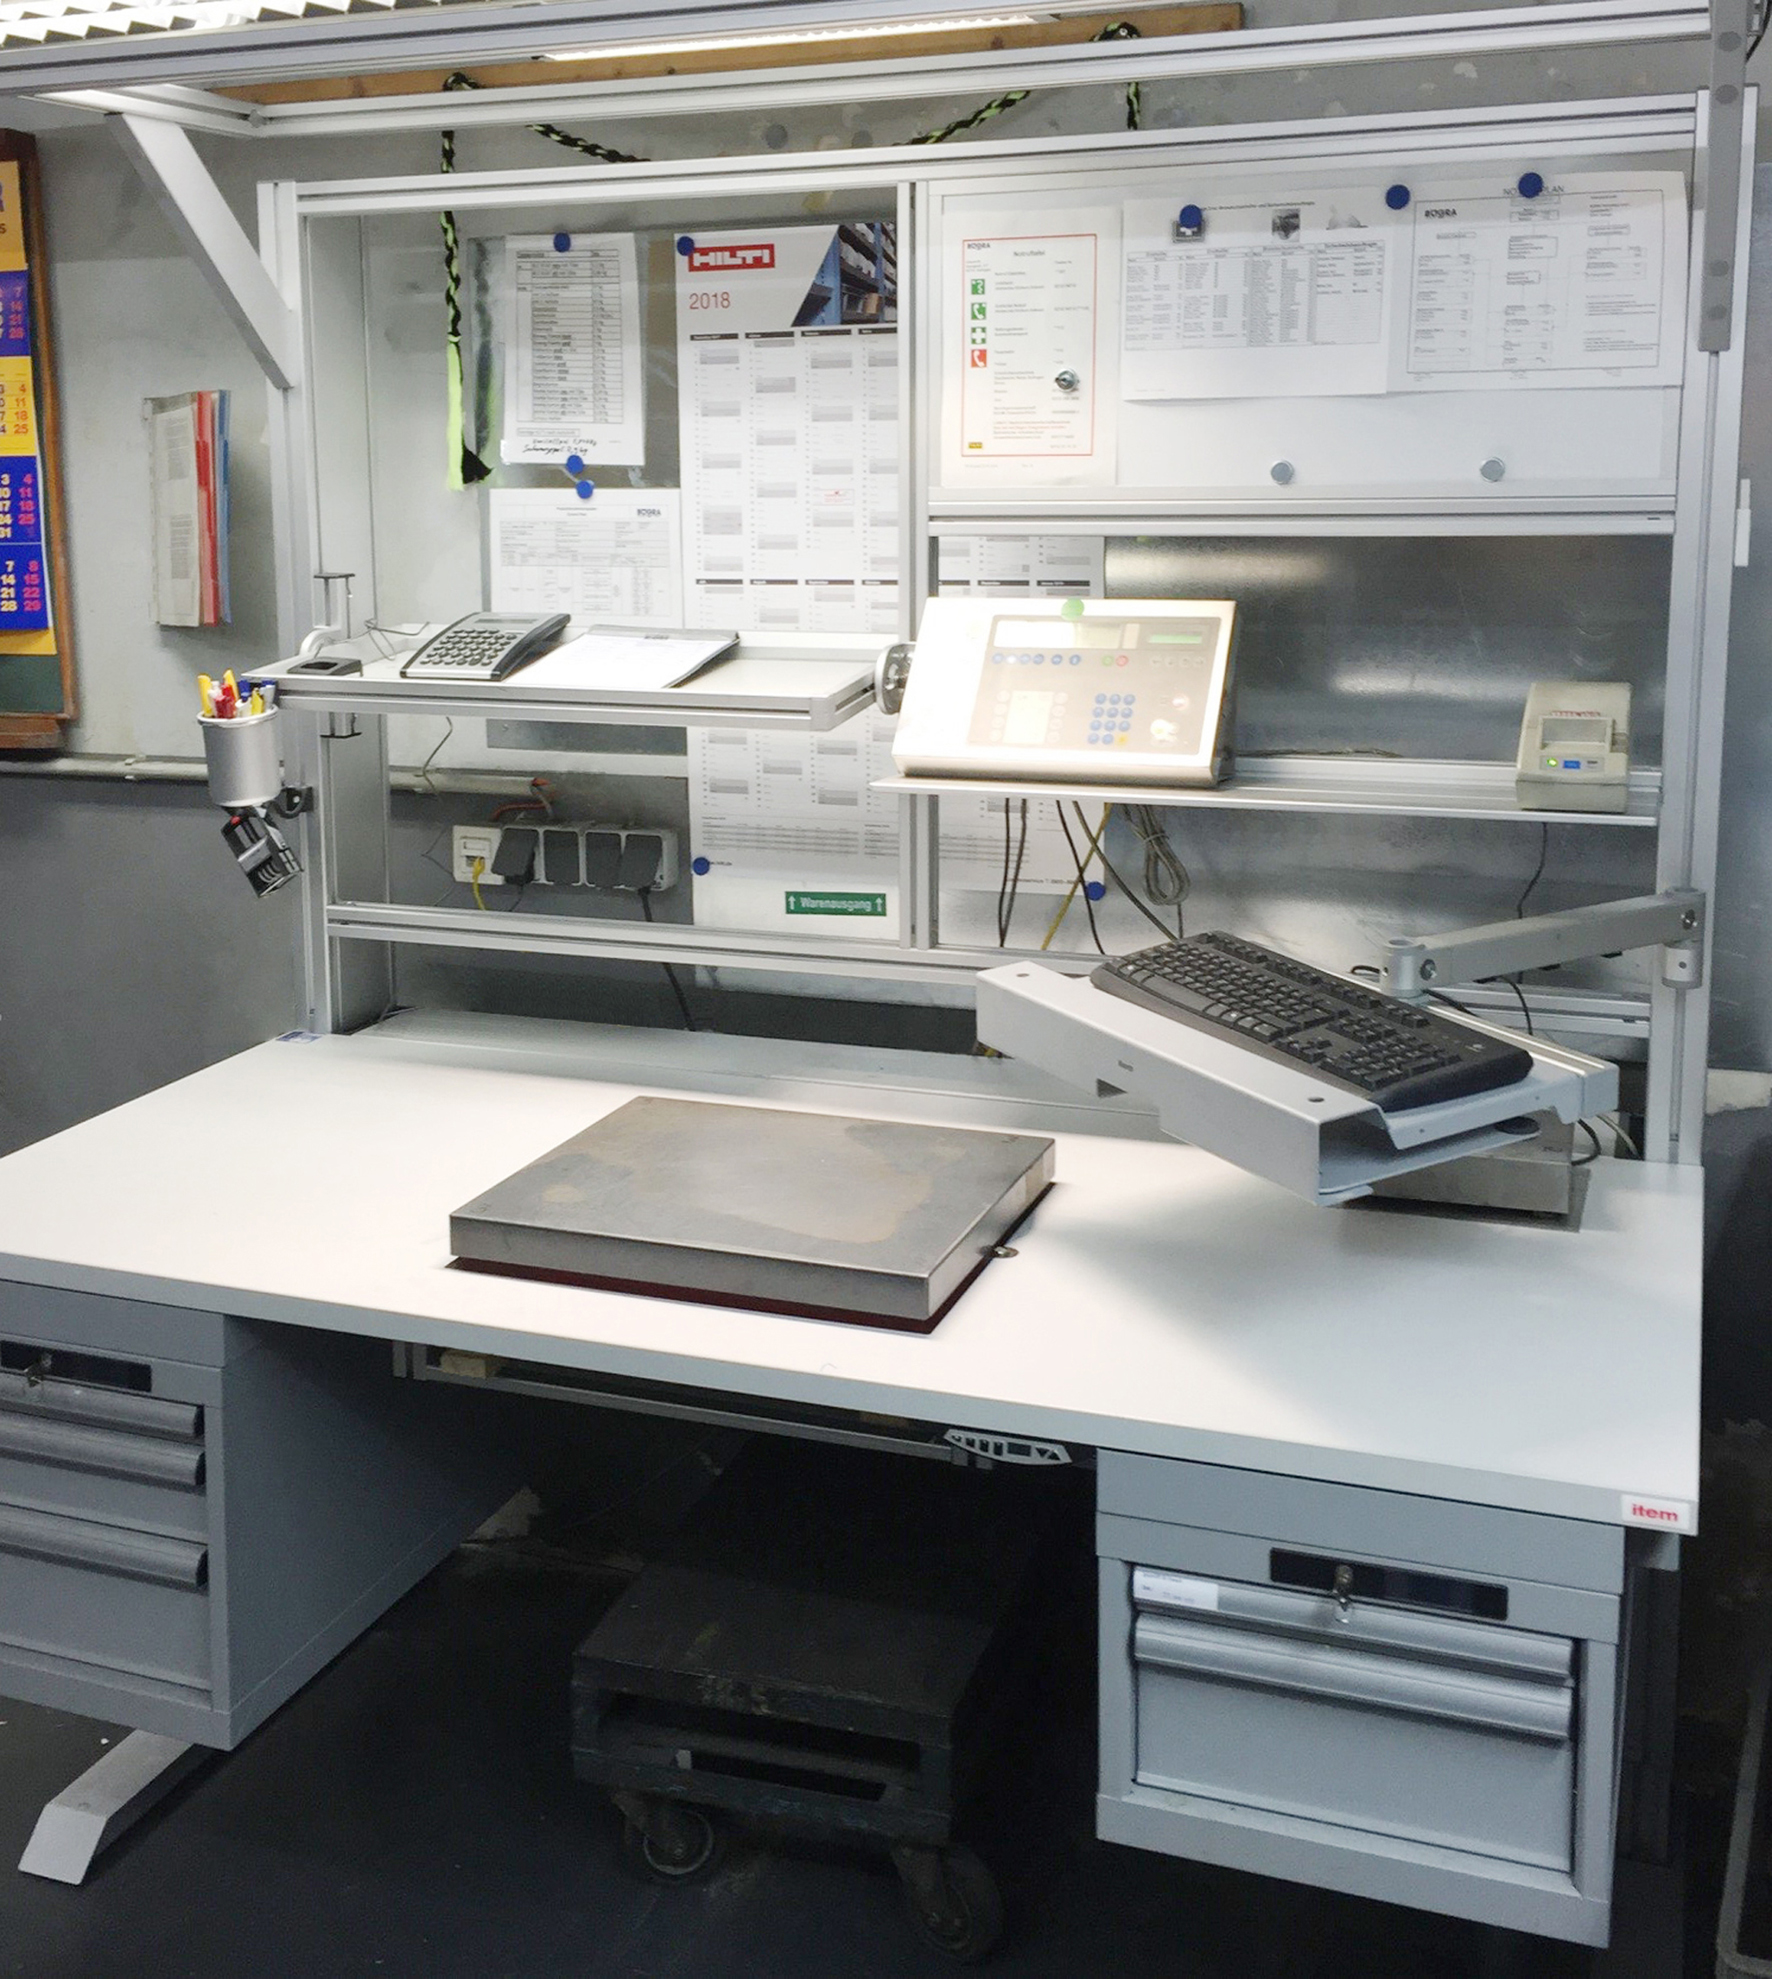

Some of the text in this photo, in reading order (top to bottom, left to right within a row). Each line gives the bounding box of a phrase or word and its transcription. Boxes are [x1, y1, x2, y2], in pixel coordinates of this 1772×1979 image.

[693, 249, 770, 267] HILTI
[689, 291, 731, 310] 2018
[1, 474, 32, 485] 3 4
[5, 560, 14, 572] 7
[1, 574, 40, 585] 14 15
[1, 587, 40, 598] 21 22
[1, 600, 17, 612] 28
[799, 896, 872, 912] Warenausgang
[1631, 1503, 1679, 1522] item
